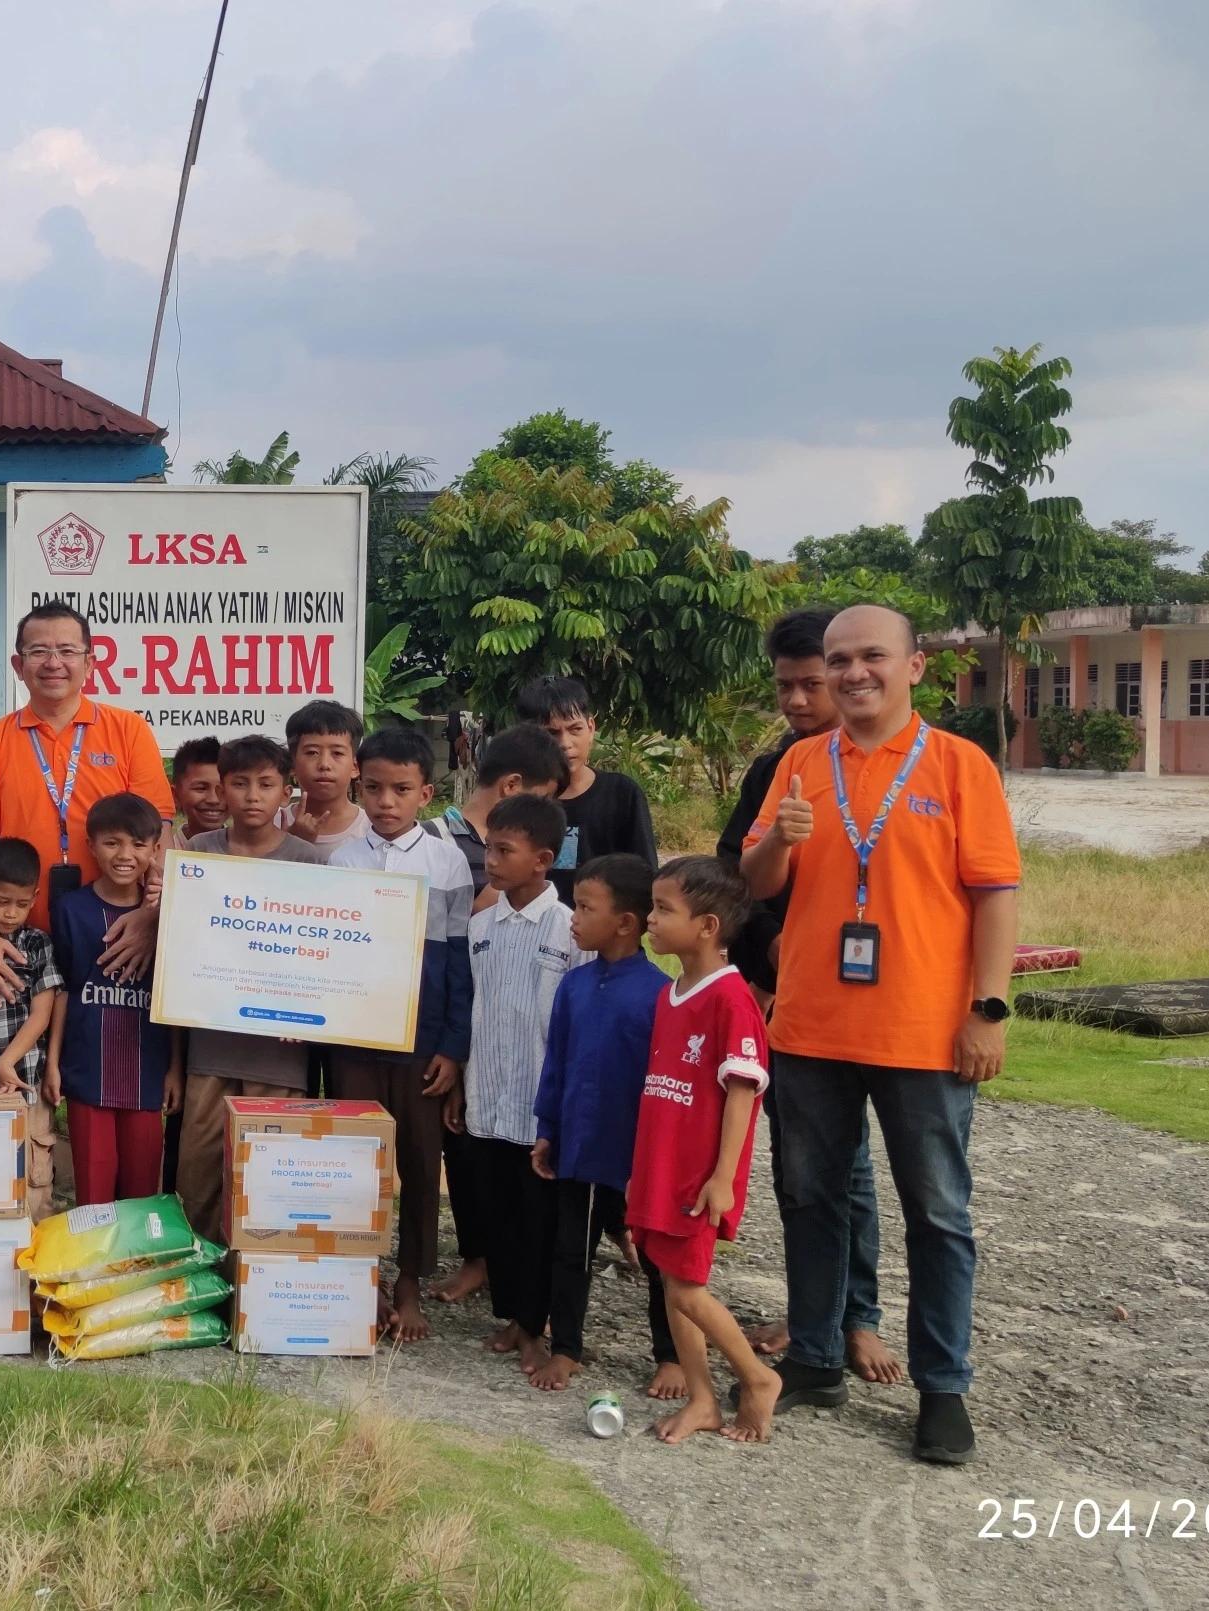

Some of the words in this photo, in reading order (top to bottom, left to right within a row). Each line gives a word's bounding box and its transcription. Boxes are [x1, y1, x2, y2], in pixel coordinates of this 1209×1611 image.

[128, 534, 247, 565] LKSA
[32, 592, 81, 613] PTI
[87, 592, 158, 624] ASUHAN
[164, 592, 213, 624] ANAK
[218, 592, 268, 624] YATIM
[273, 592, 279, 623] /
[284, 592, 343, 623] MISKIN
[82, 635, 335, 695] R-RAHIM
[160, 710, 265, 726] PEKANBARU
[223, 894, 257, 911] tob
[263, 896, 362, 922] insurance
[210, 915, 292, 935] PROGRAM
[297, 925, 329, 939] CSR
[333, 928, 372, 944] 2024
[248, 940, 330, 960] #toberbagi
[81, 981, 152, 1010] Emirate
[271, 1170, 313, 1178] PROGRAM
[297, 1159, 346, 1168] insurance
[268, 1292, 311, 1300] PROGRAM
[294, 1280, 345, 1290] insurance
